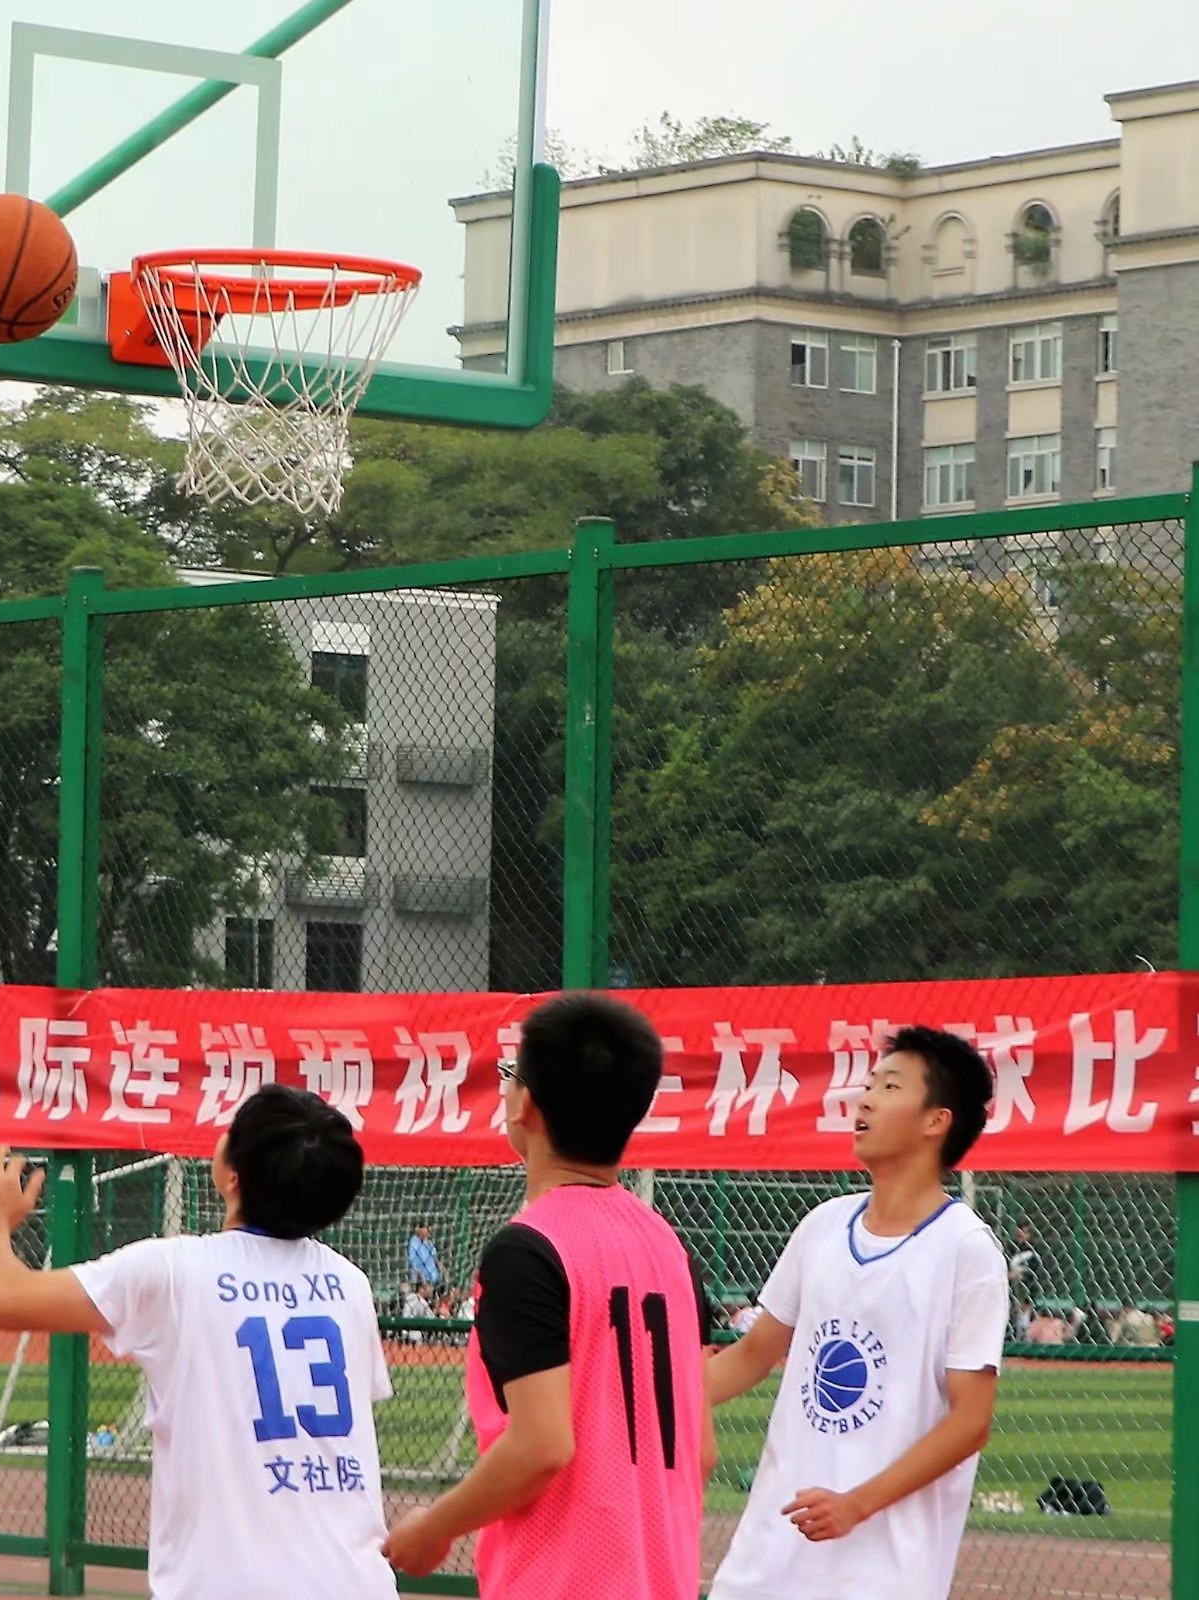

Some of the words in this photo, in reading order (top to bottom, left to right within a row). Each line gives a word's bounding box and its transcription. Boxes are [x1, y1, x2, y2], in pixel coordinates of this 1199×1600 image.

[217, 1272, 298, 1310] Song
[302, 1273, 346, 1302] XR
[235, 1315, 354, 1443] 13
[608, 1285, 676, 1471] 11
[263, 1454, 367, 1495] 文社院
